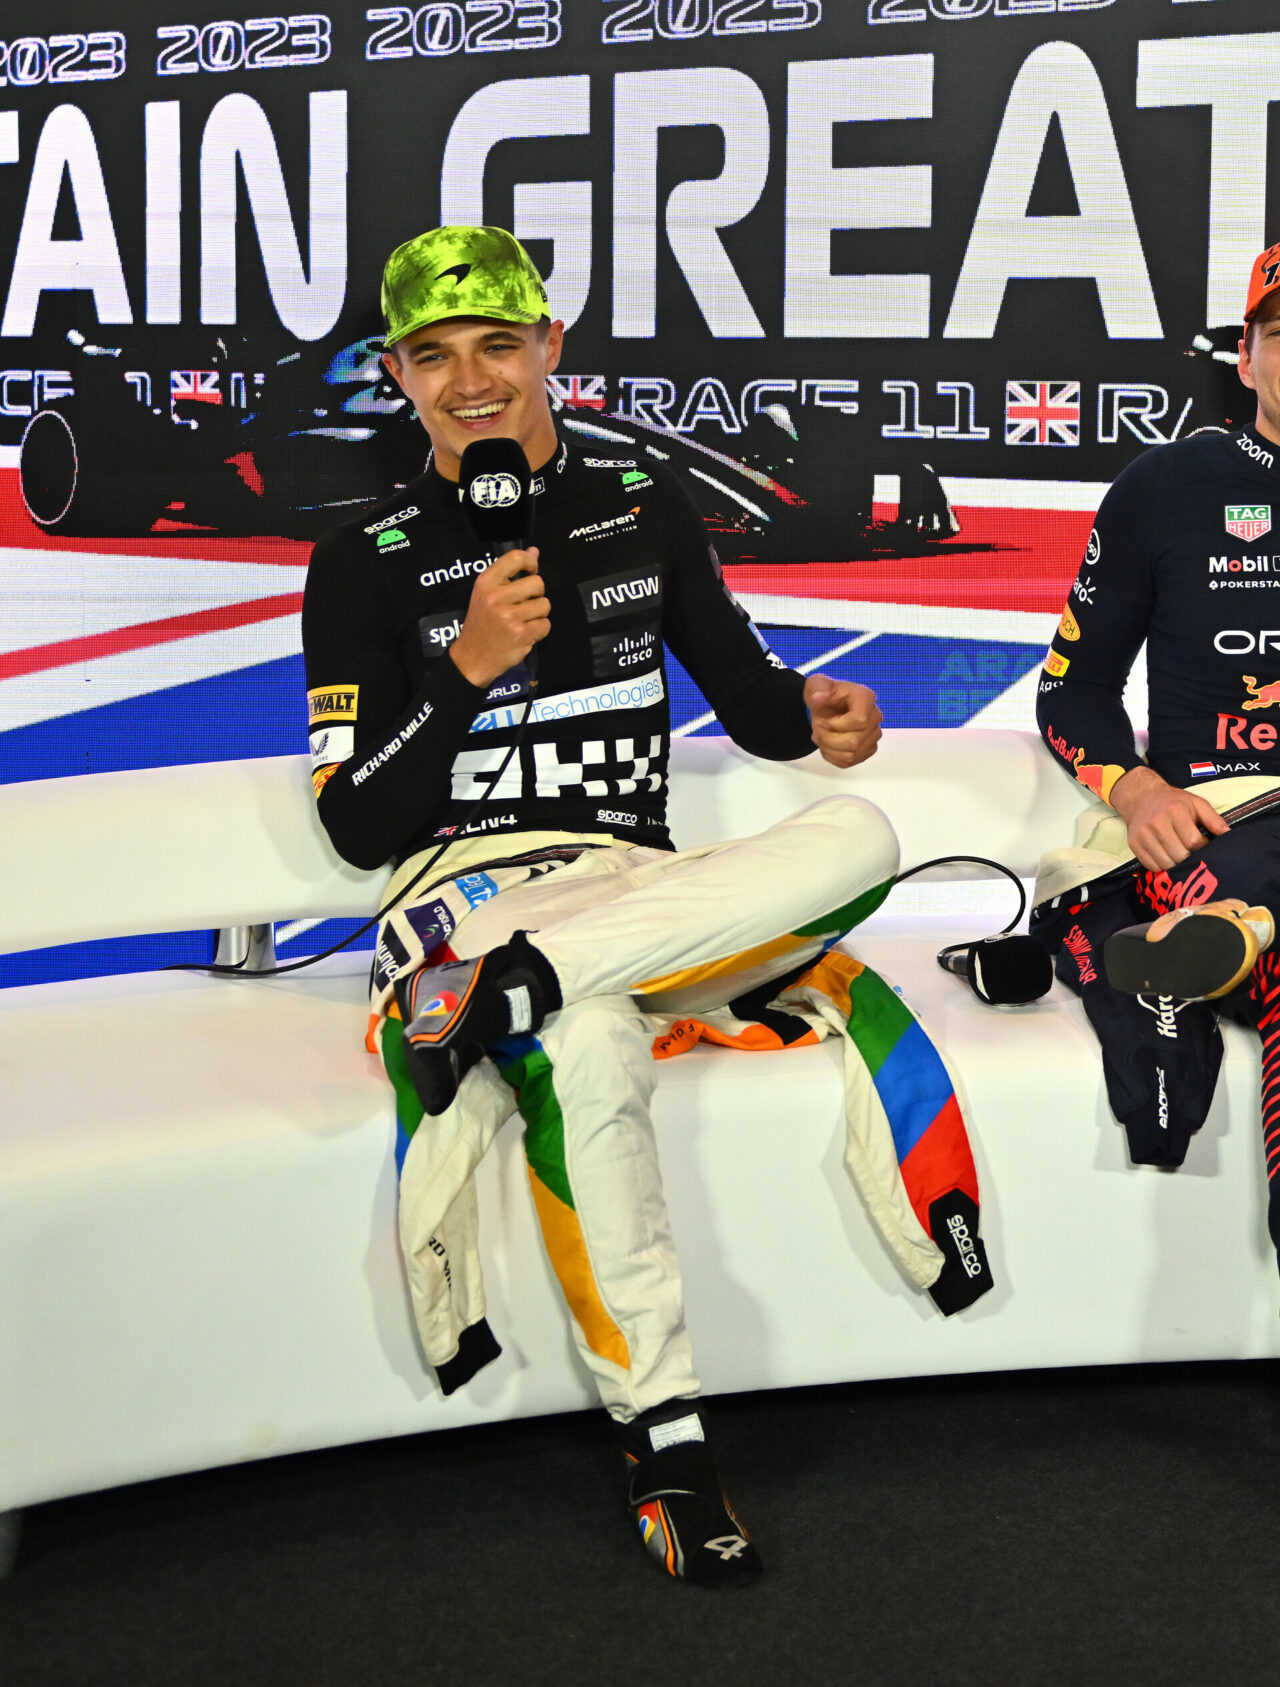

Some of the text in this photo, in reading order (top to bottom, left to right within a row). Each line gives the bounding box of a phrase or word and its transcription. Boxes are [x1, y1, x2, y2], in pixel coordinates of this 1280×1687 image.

[156, 14, 332, 76] 2023
[366, 0, 563, 60] 2023
[881, 380, 990, 440] 11
[583, 457, 638, 468] sparco
[1237, 433, 1274, 469] zoom
[624, 479, 653, 493] android
[363, 506, 421, 535] sparco
[1229, 507, 1268, 519] TAG
[568, 514, 635, 539] McLaren
[1228, 521, 1268, 538] HEUER
[379, 540, 411, 554] android
[420, 552, 498, 587] androi
[1208, 555, 1268, 573] Mobil
[429, 619, 465, 648] spl
[618, 648, 652, 667] CISCO
[531, 677, 661, 723] Technologies
[352, 702, 433, 786] RICHARD MILLE
[1057, 736, 1077, 763] Bull
[1217, 762, 1262, 773] MAX
[596, 809, 638, 827] sparco
[946, 1214, 982, 1279] sparco
[704, 1535, 748, 1560] 4
